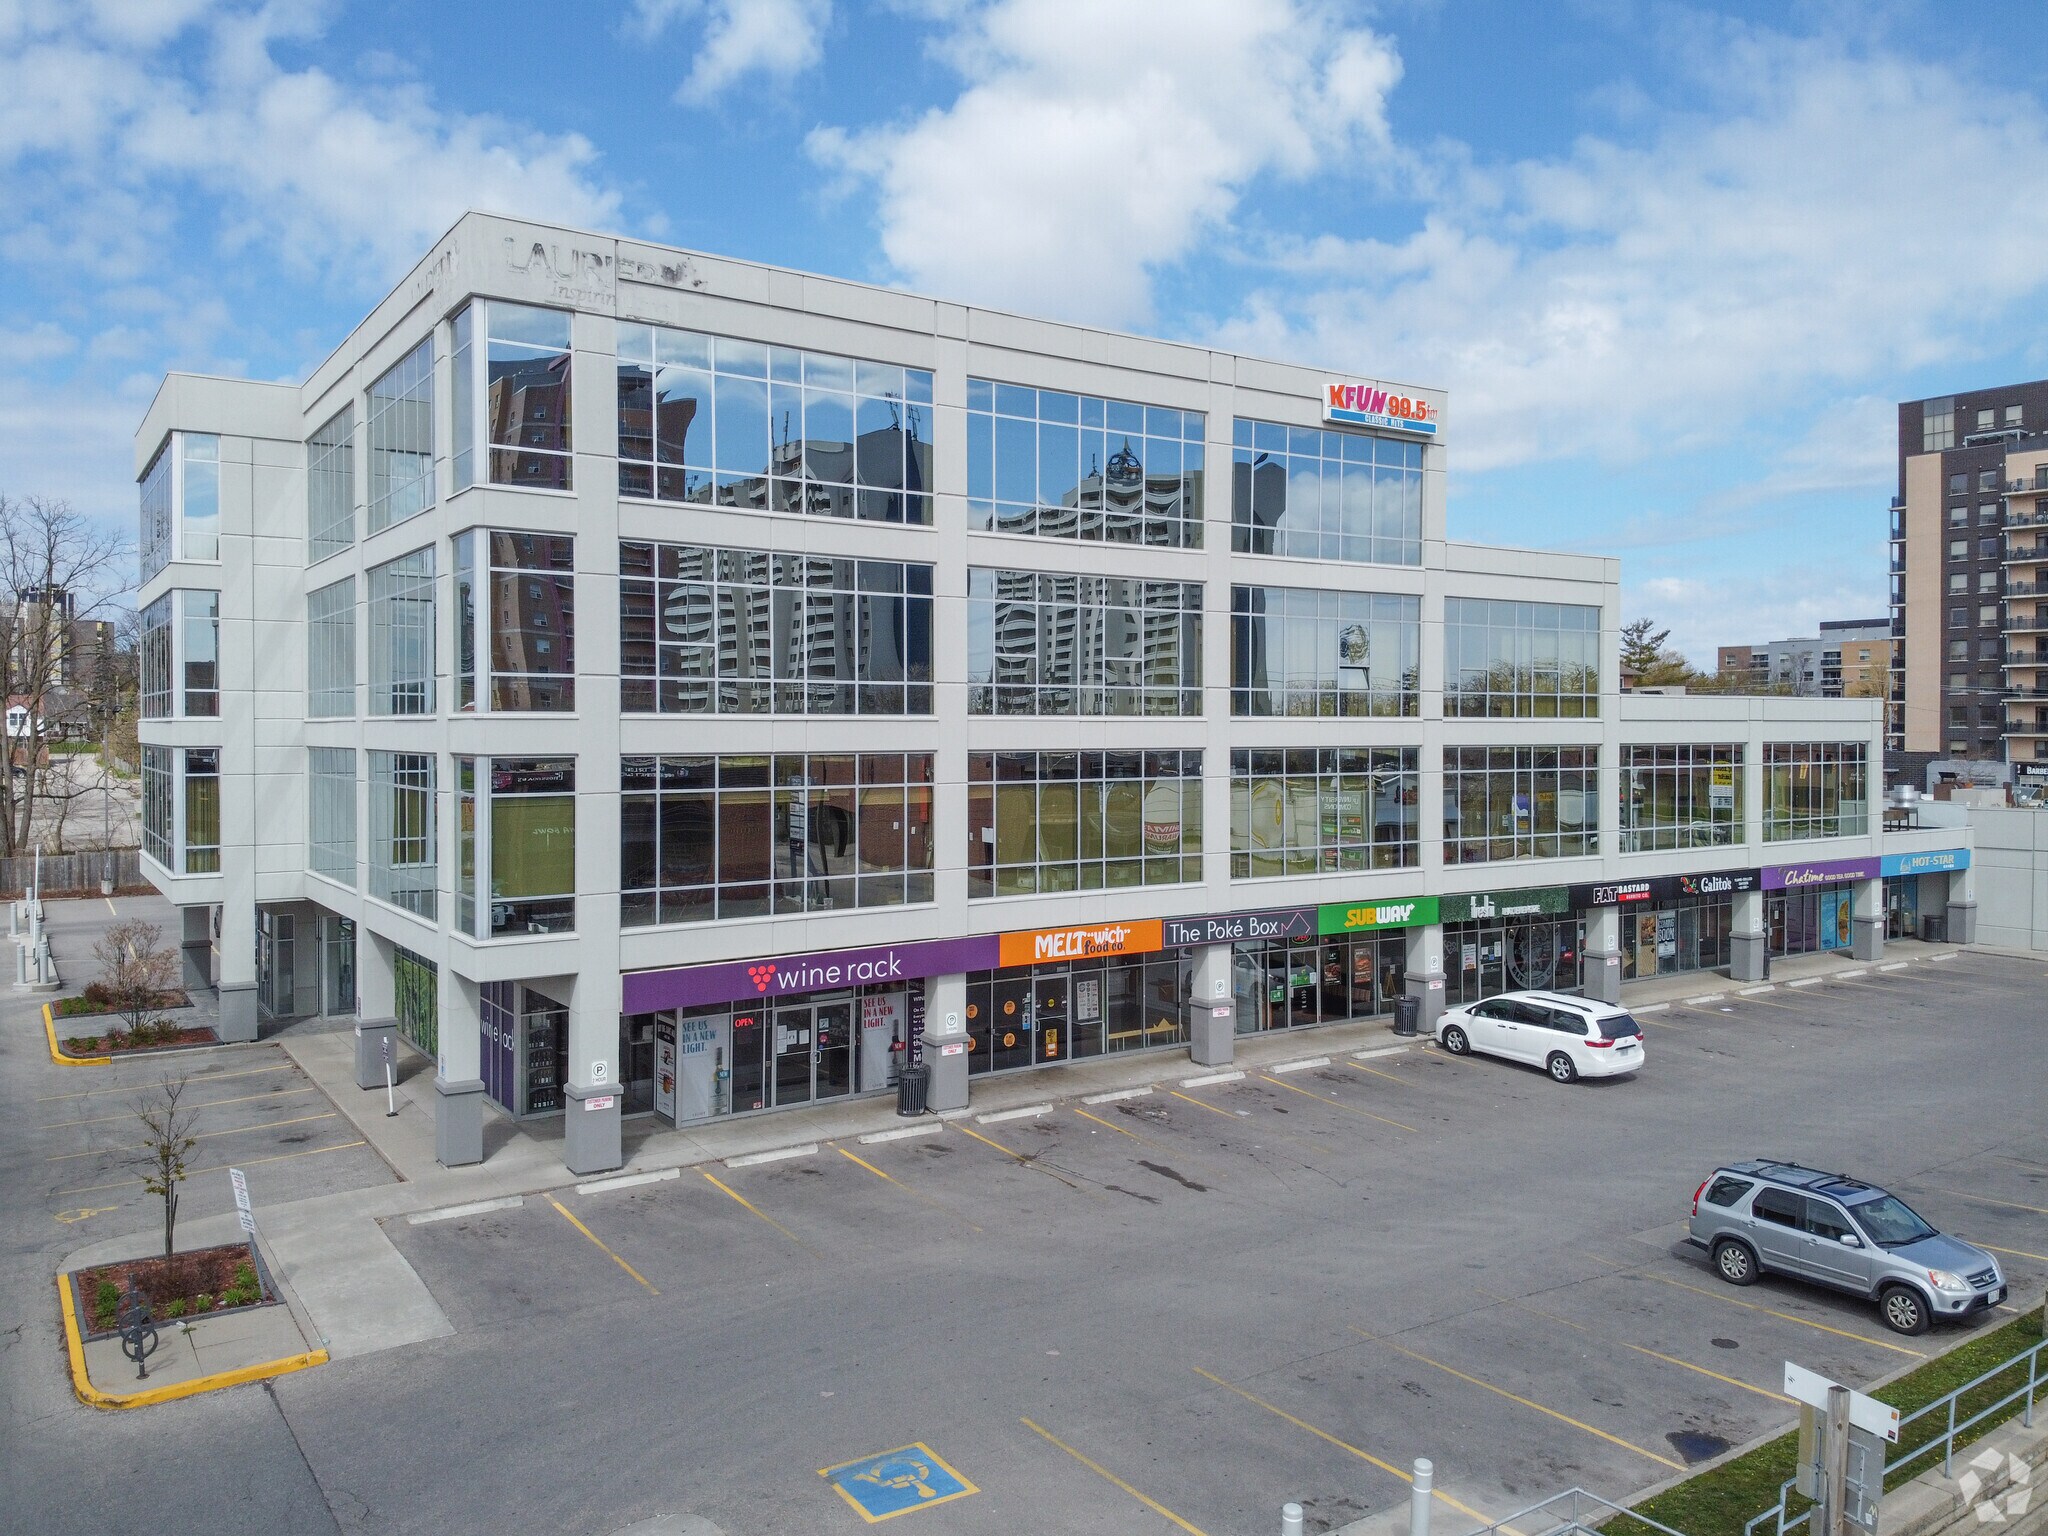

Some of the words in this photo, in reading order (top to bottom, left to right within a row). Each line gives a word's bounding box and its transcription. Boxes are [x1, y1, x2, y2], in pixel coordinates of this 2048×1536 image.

[1329, 384, 1388, 414] KFUN
[1388, 396, 1427, 421] 99.5
[1364, 414, 1389, 426] CLASSIC
[1390, 418, 1405, 428] HITS
[1912, 854, 1955, 868] HOT-STAR
[1700, 876, 1732, 893] Galito's
[1785, 869, 1825, 886] Chatime
[1593, 886, 1618, 904] FAT
[1618, 883, 1650, 894] BASTARD
[1344, 903, 1415, 928] SUBWAY
[1169, 923, 1201, 943] The
[1207, 919, 1244, 940] Poké
[1249, 917, 1278, 936] Box
[1658, 927, 1675, 942] SOON
[1084, 940, 1109, 955] food
[1111, 941, 1126, 951] co.
[777, 962, 841, 990] wine
[847, 950, 902, 981] rack
[864, 997, 876, 1008] SEE
[876, 996, 887, 1006] US
[864, 1008, 872, 1019] IN
[872, 1007, 878, 1017] A
[879, 1005, 894, 1016] NEW
[682, 1021, 697, 1033] SEE
[697, 1019, 709, 1031] US
[734, 1017, 755, 1028] OPEN
[863, 1017, 887, 1029] LIGHT.
[682, 1033, 692, 1044] IN
[692, 1032, 699, 1043] A
[699, 1030, 717, 1041] NEW
[682, 1042, 708, 1055] LIGHT.
